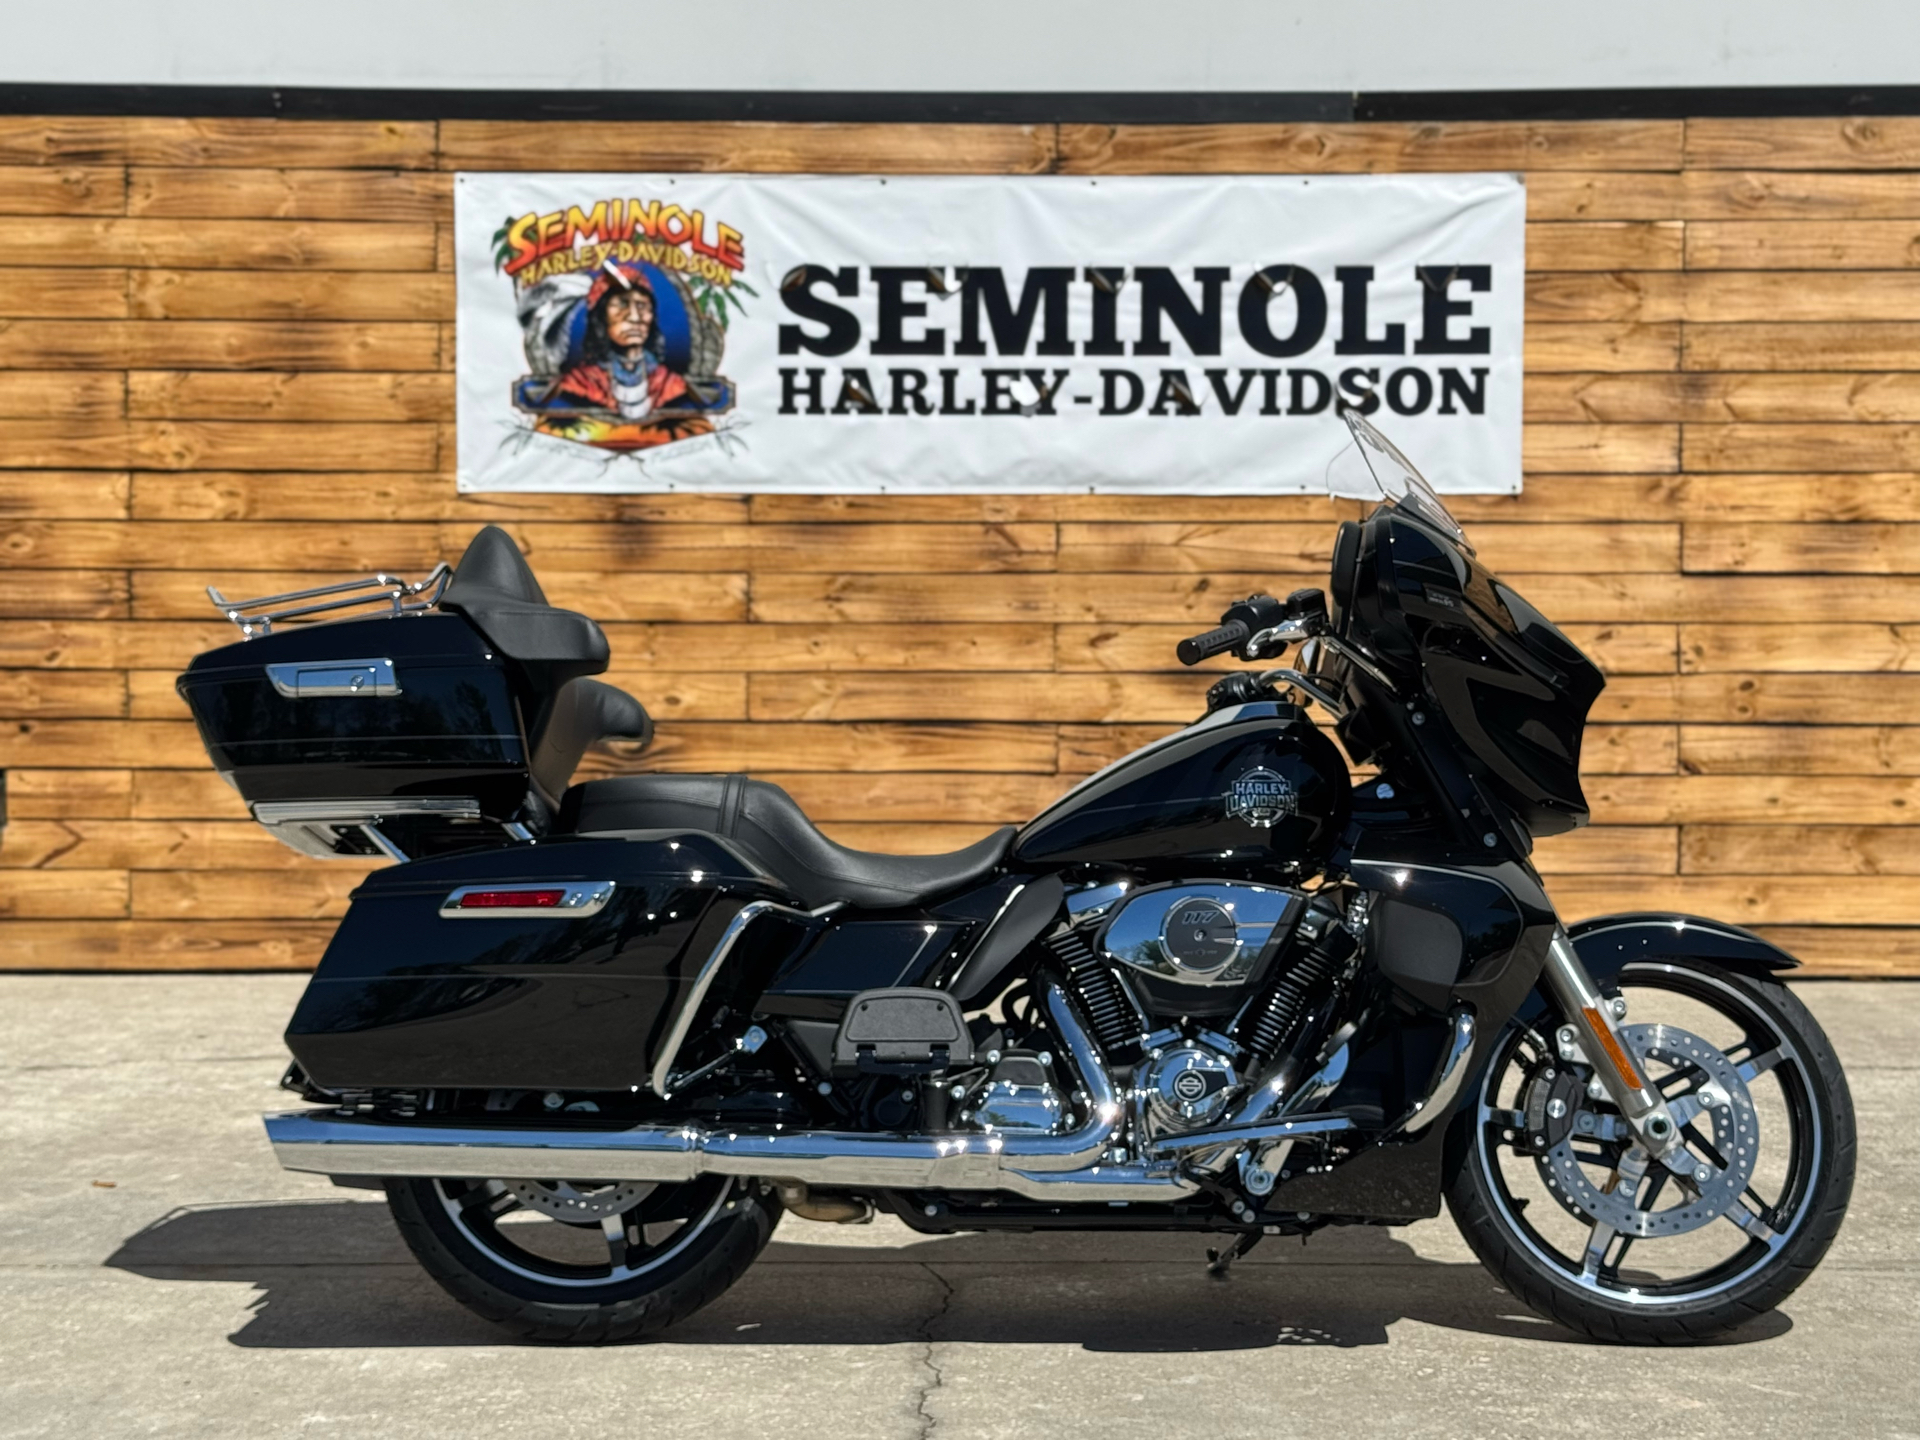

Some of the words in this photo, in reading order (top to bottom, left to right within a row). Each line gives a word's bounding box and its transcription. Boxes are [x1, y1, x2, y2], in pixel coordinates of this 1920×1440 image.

[503, 198, 745, 276] SEMINOLE
[520, 241, 732, 288] HARLEY-DAVIDSON
[778, 264, 1491, 357] SEMINOLE
[778, 367, 1490, 417] HARLEY-DAVIDSON
[1182, 910, 1219, 925] 117
